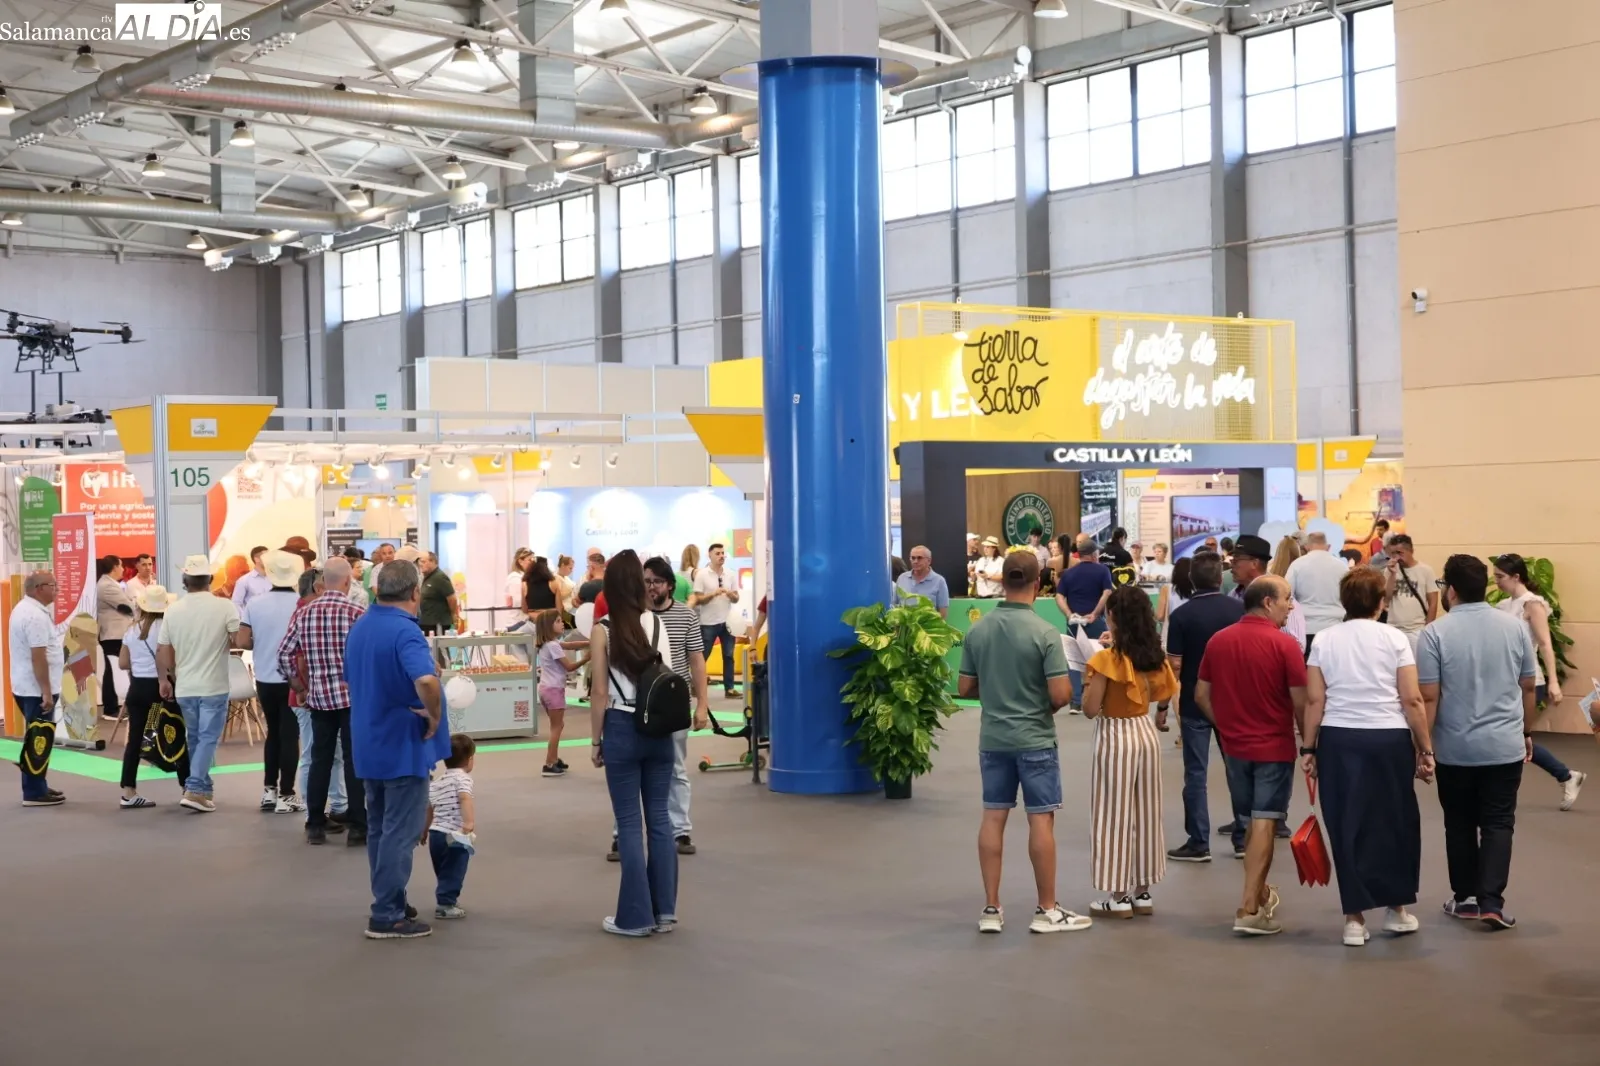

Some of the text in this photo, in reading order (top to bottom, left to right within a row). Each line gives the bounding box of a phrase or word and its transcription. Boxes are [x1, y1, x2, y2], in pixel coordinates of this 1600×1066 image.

[964, 329, 1049, 366] tierra
[971, 363, 999, 385] de
[978, 363, 1049, 415] sabor
[1053, 443, 1193, 463] CASTILLA Y LEÓN
[170, 467, 211, 488] 105
[1125, 486, 1141, 497] 100
[80, 502, 97, 511] Por
[1007, 497, 1051, 536] CAMINO DE HIERRO
